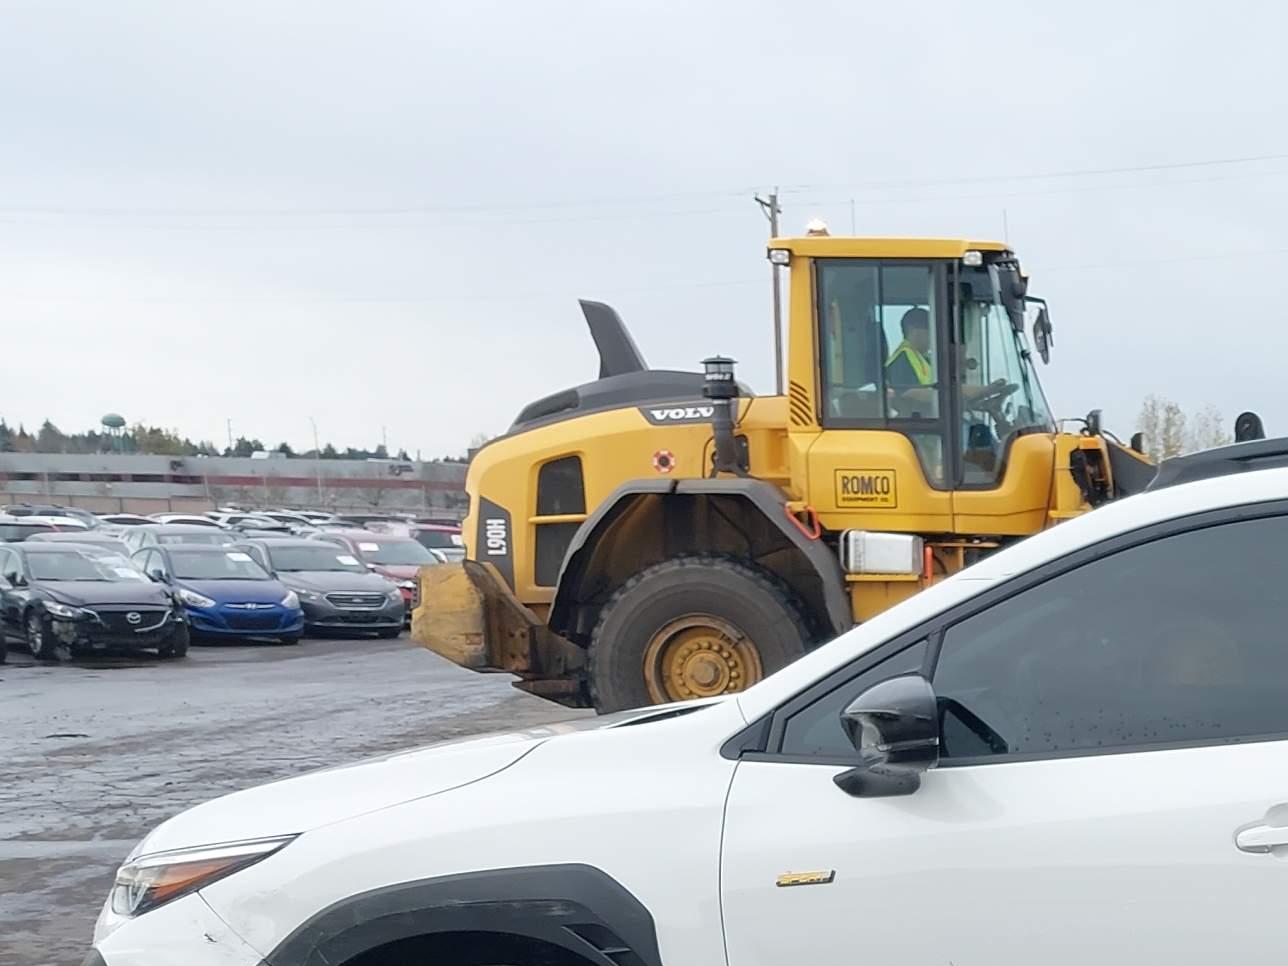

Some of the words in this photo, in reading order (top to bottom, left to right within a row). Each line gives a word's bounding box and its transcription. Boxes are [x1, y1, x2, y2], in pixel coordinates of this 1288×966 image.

[650, 406, 715, 421] VOLV
[841, 475, 890, 495] ROMCO
[486, 518, 507, 555] L90H
